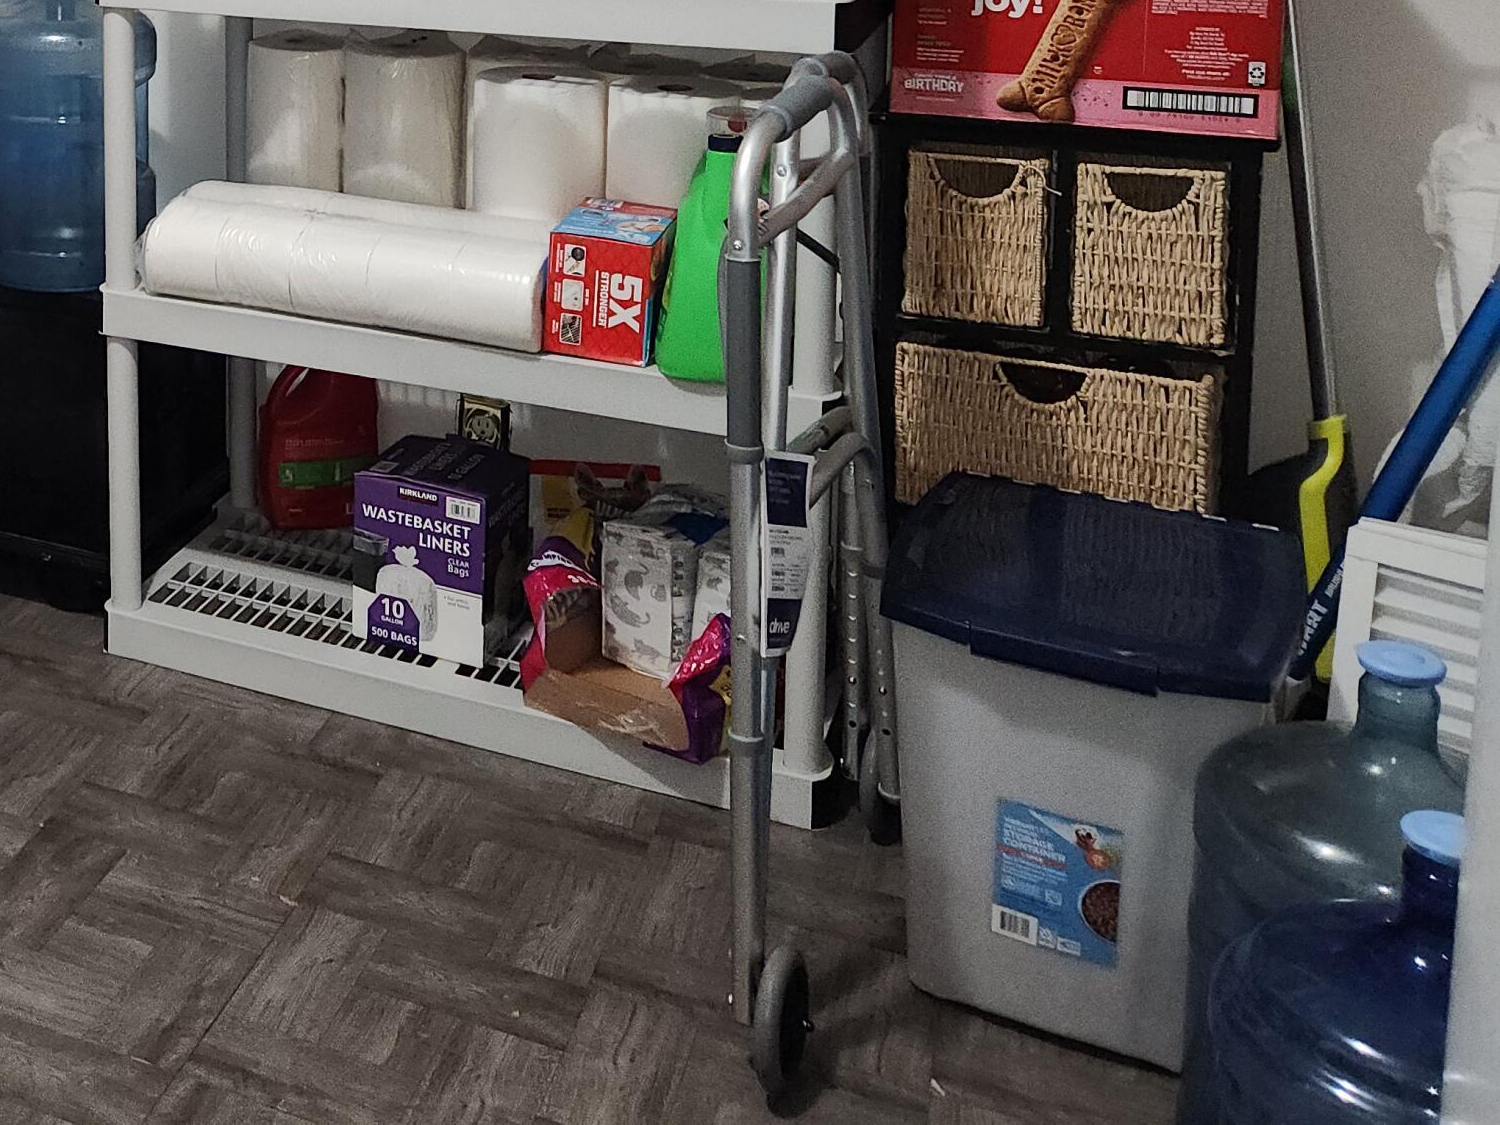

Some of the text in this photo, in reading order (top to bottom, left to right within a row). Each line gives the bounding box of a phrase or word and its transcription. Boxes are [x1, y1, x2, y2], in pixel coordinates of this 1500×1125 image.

[903, 77, 965, 93] BIRTHDAY
[598, 271, 610, 329] STRONGER
[608, 273, 643, 334] 5X
[399, 487, 438, 502] KIRKLAND
[362, 503, 471, 540] WASTEBASKET
[418, 532, 470, 558] LINERS
[447, 557, 469, 568] CLEAR
[447, 565, 470, 578] Bags
[381, 597, 405, 619] 10
[380, 615, 404, 626] GALLON
[769, 618, 790, 635] drive
[371, 626, 418, 647] 500 BAGS
